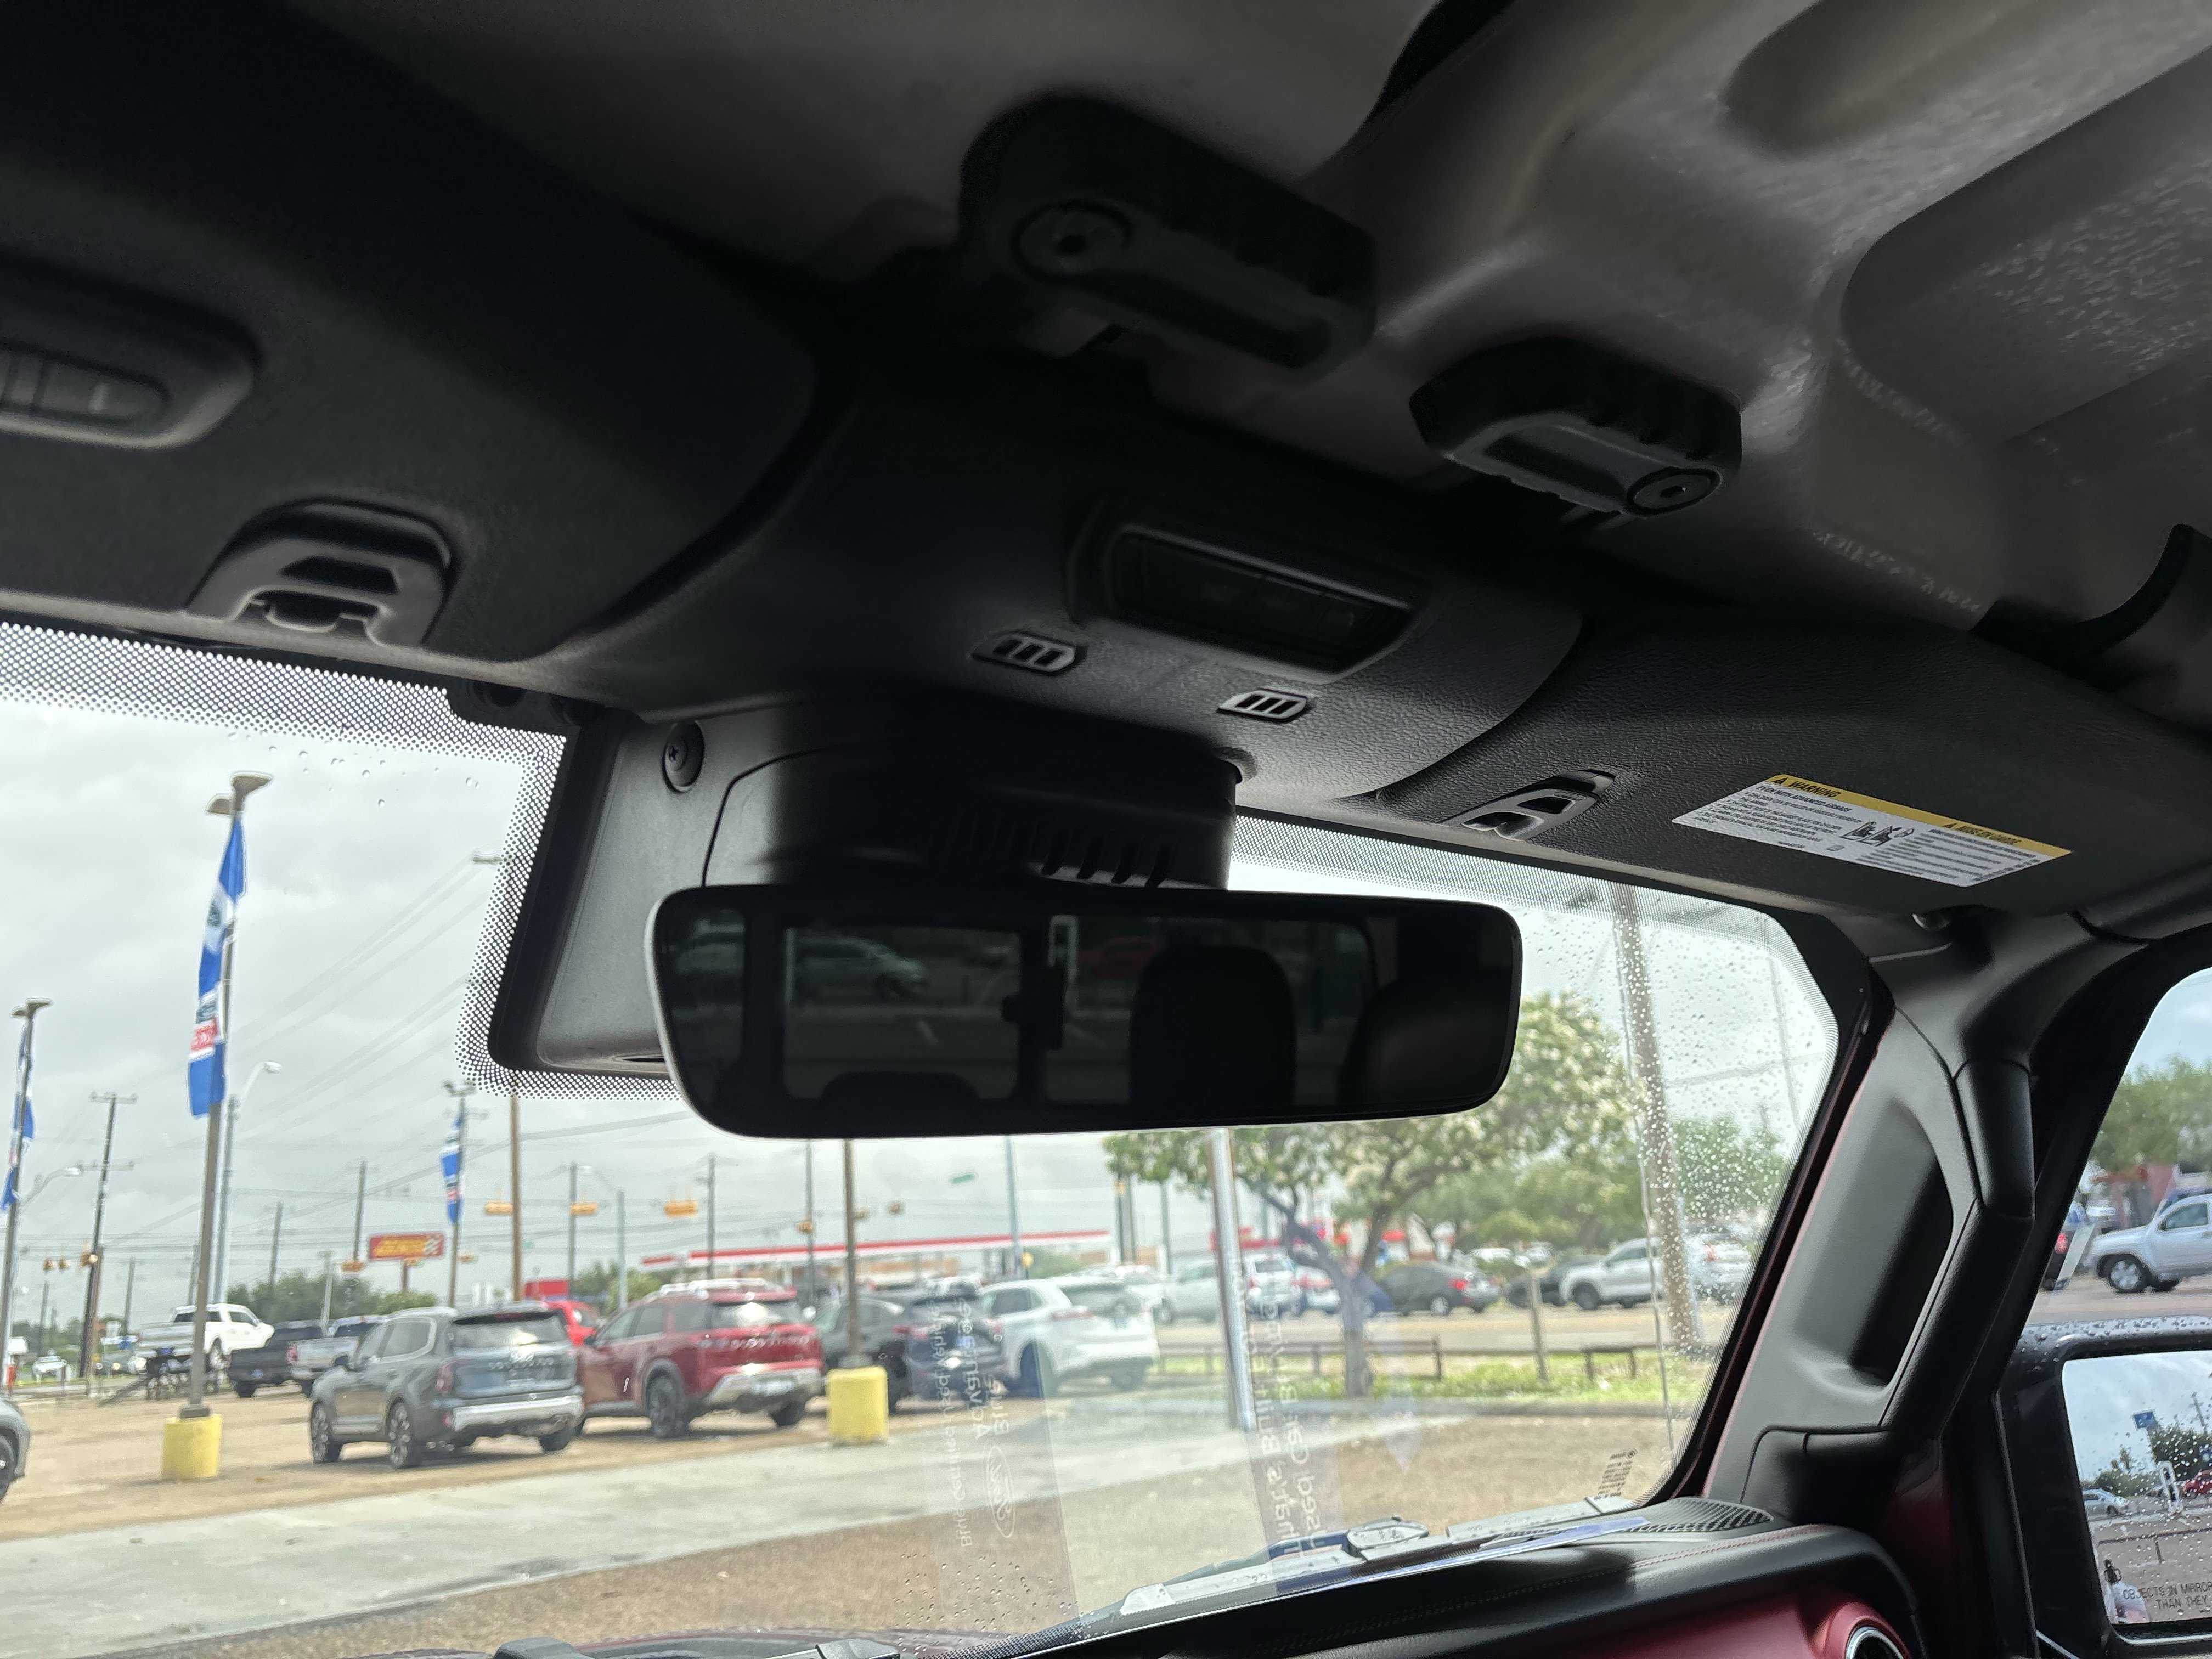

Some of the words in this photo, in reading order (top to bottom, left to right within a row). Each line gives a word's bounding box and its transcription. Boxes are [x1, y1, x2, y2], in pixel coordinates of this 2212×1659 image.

[1788, 781, 1842, 798] WARNING
[2123, 1585, 2164, 1600] OBJECTS
[2155, 1598, 2182, 1610] THAN
[2185, 1595, 2208, 1607] THEY
